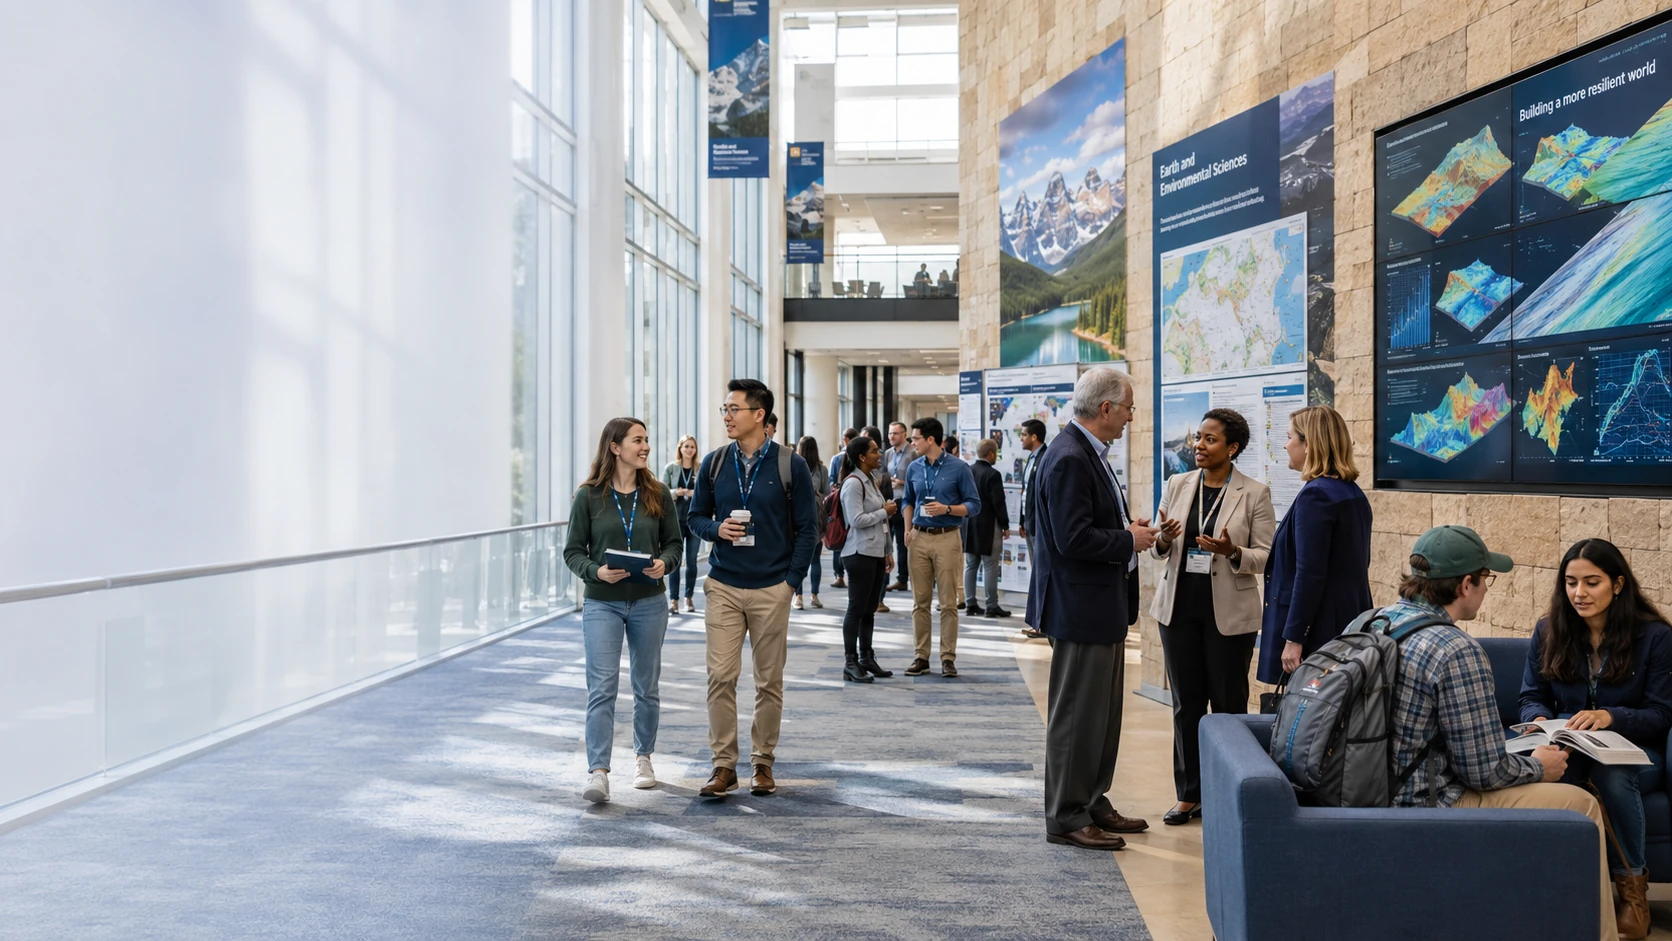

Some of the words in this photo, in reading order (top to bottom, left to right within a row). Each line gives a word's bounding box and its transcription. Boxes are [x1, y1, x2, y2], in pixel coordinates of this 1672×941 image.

[1519, 101, 1554, 122] Building
[1555, 98, 1562, 108] a
[1563, 89, 1586, 106] more
[1587, 71, 1626, 97] resilient
[1628, 59, 1656, 82] world
[1160, 160, 1180, 179] Earth
[1181, 152, 1195, 171] and
[1160, 165, 1212, 197] Environmental
[1213, 154, 1248, 177] Sciences
